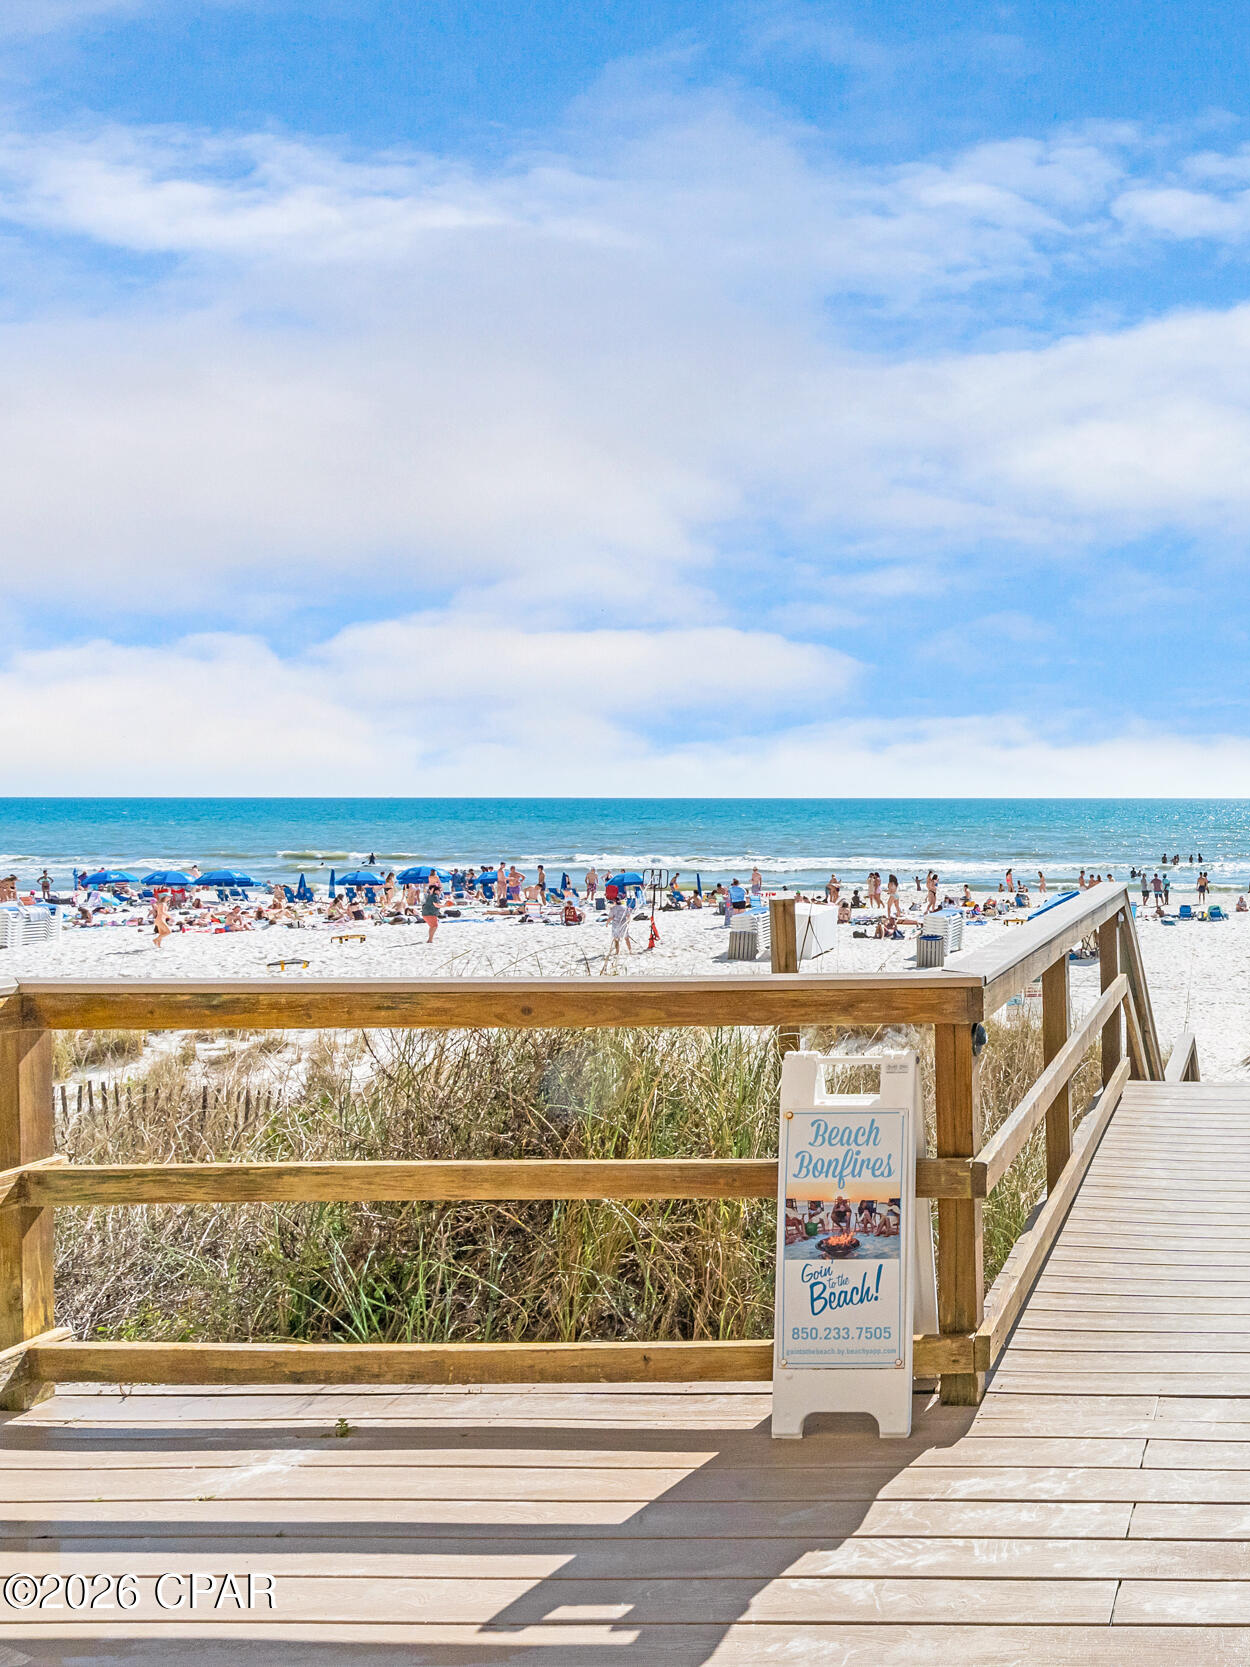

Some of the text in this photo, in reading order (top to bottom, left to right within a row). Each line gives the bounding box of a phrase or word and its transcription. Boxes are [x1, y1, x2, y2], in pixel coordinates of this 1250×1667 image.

[808, 1118, 882, 1148] Beach
[792, 1149, 895, 1190] Bonfires
[809, 1263, 883, 1316] Beach!
[837, 1273, 849, 1287] the
[791, 1326, 892, 1340] 850.233.7505
